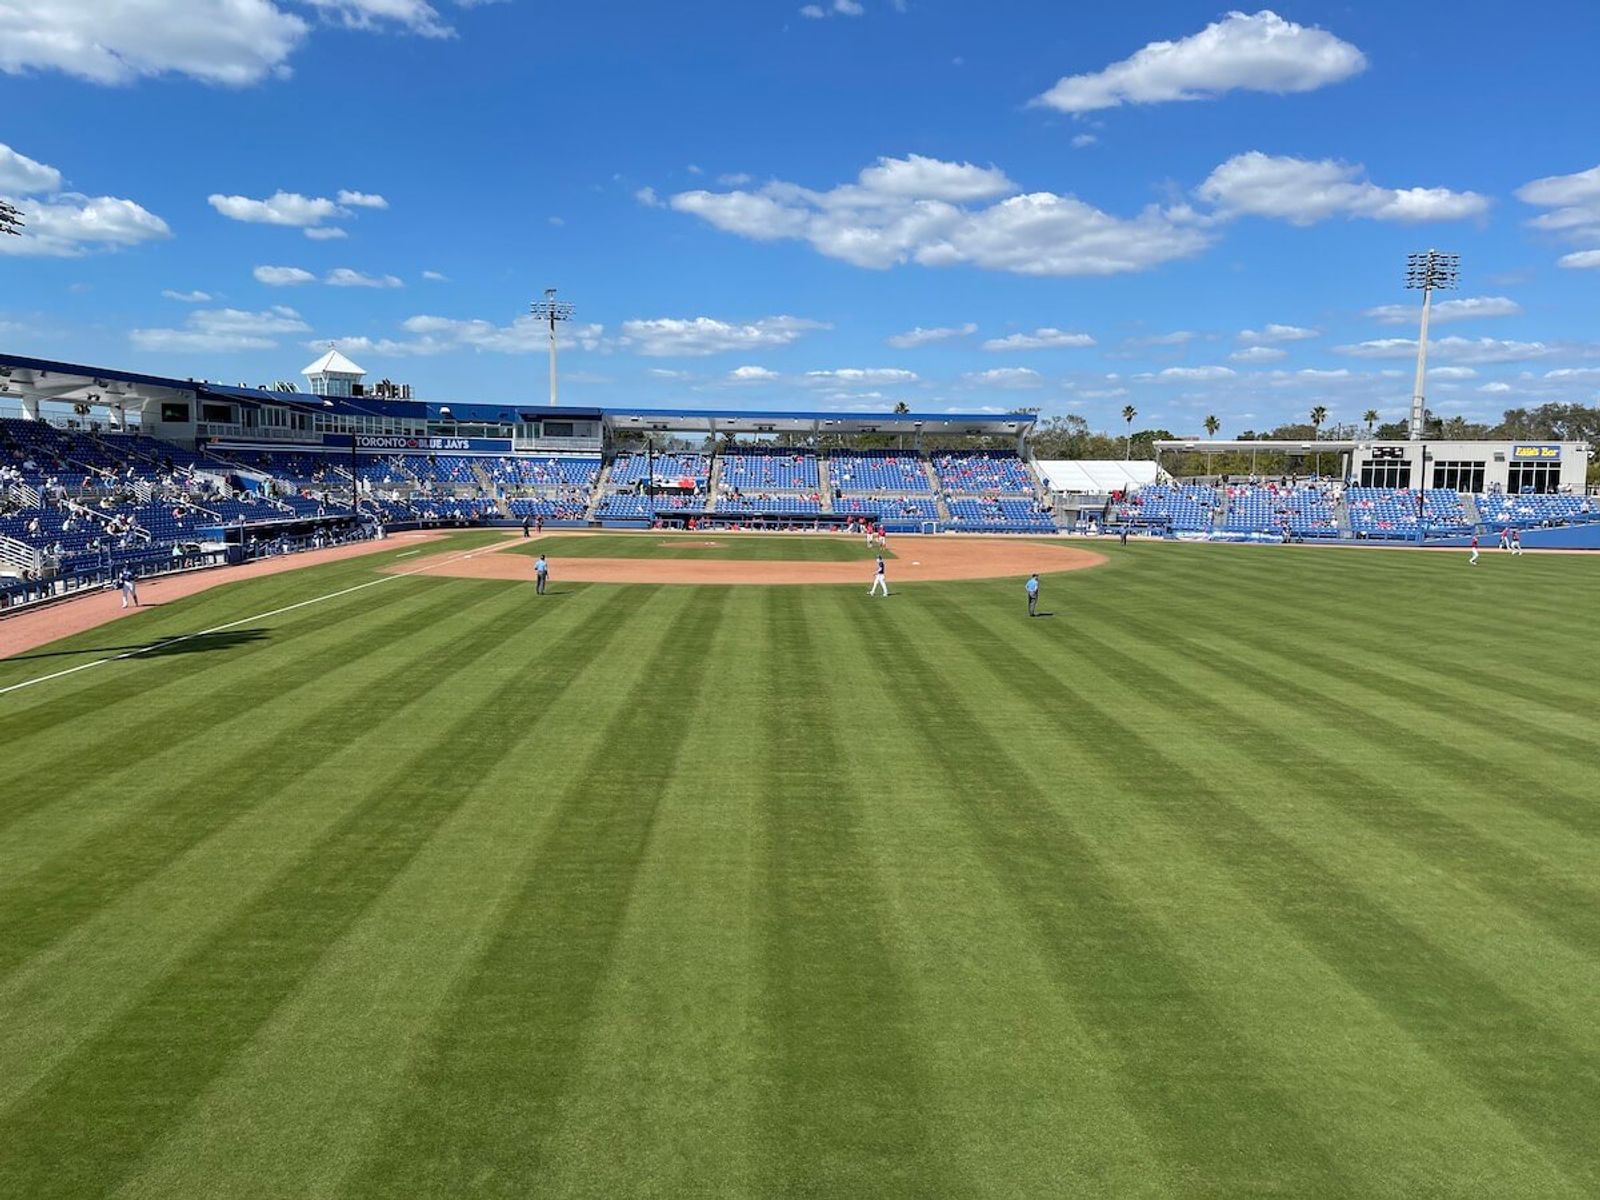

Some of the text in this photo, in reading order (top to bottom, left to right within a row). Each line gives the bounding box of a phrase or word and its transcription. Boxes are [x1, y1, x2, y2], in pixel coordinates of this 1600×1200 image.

[355, 436, 470, 449] TORONTO BLUE JAYS
